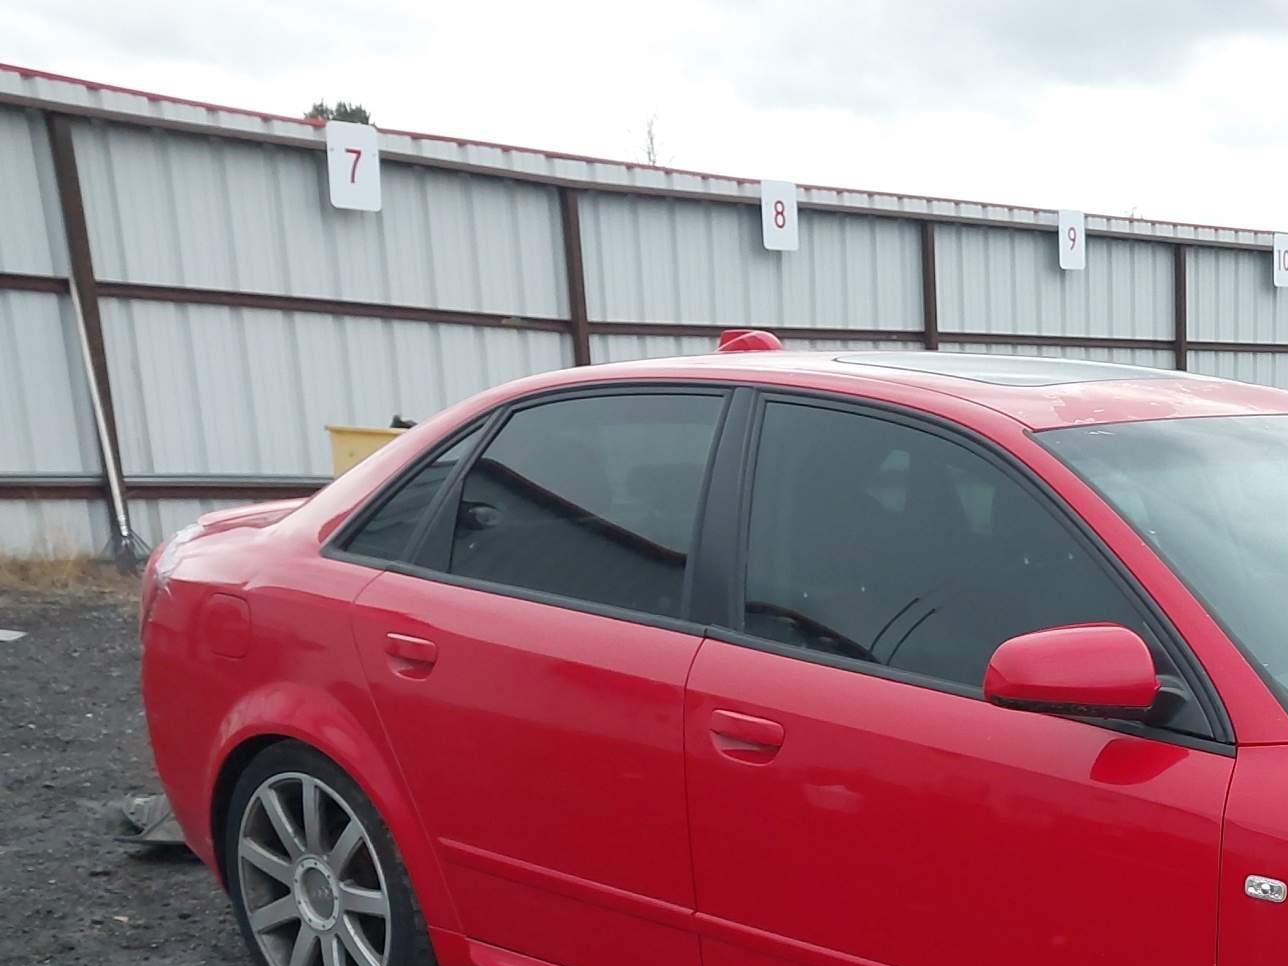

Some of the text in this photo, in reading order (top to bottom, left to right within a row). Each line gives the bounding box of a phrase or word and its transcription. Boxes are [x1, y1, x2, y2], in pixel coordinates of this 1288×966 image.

[344, 147, 362, 184] 7
[774, 200, 786, 229] 8
[1067, 226, 1077, 251] 9
